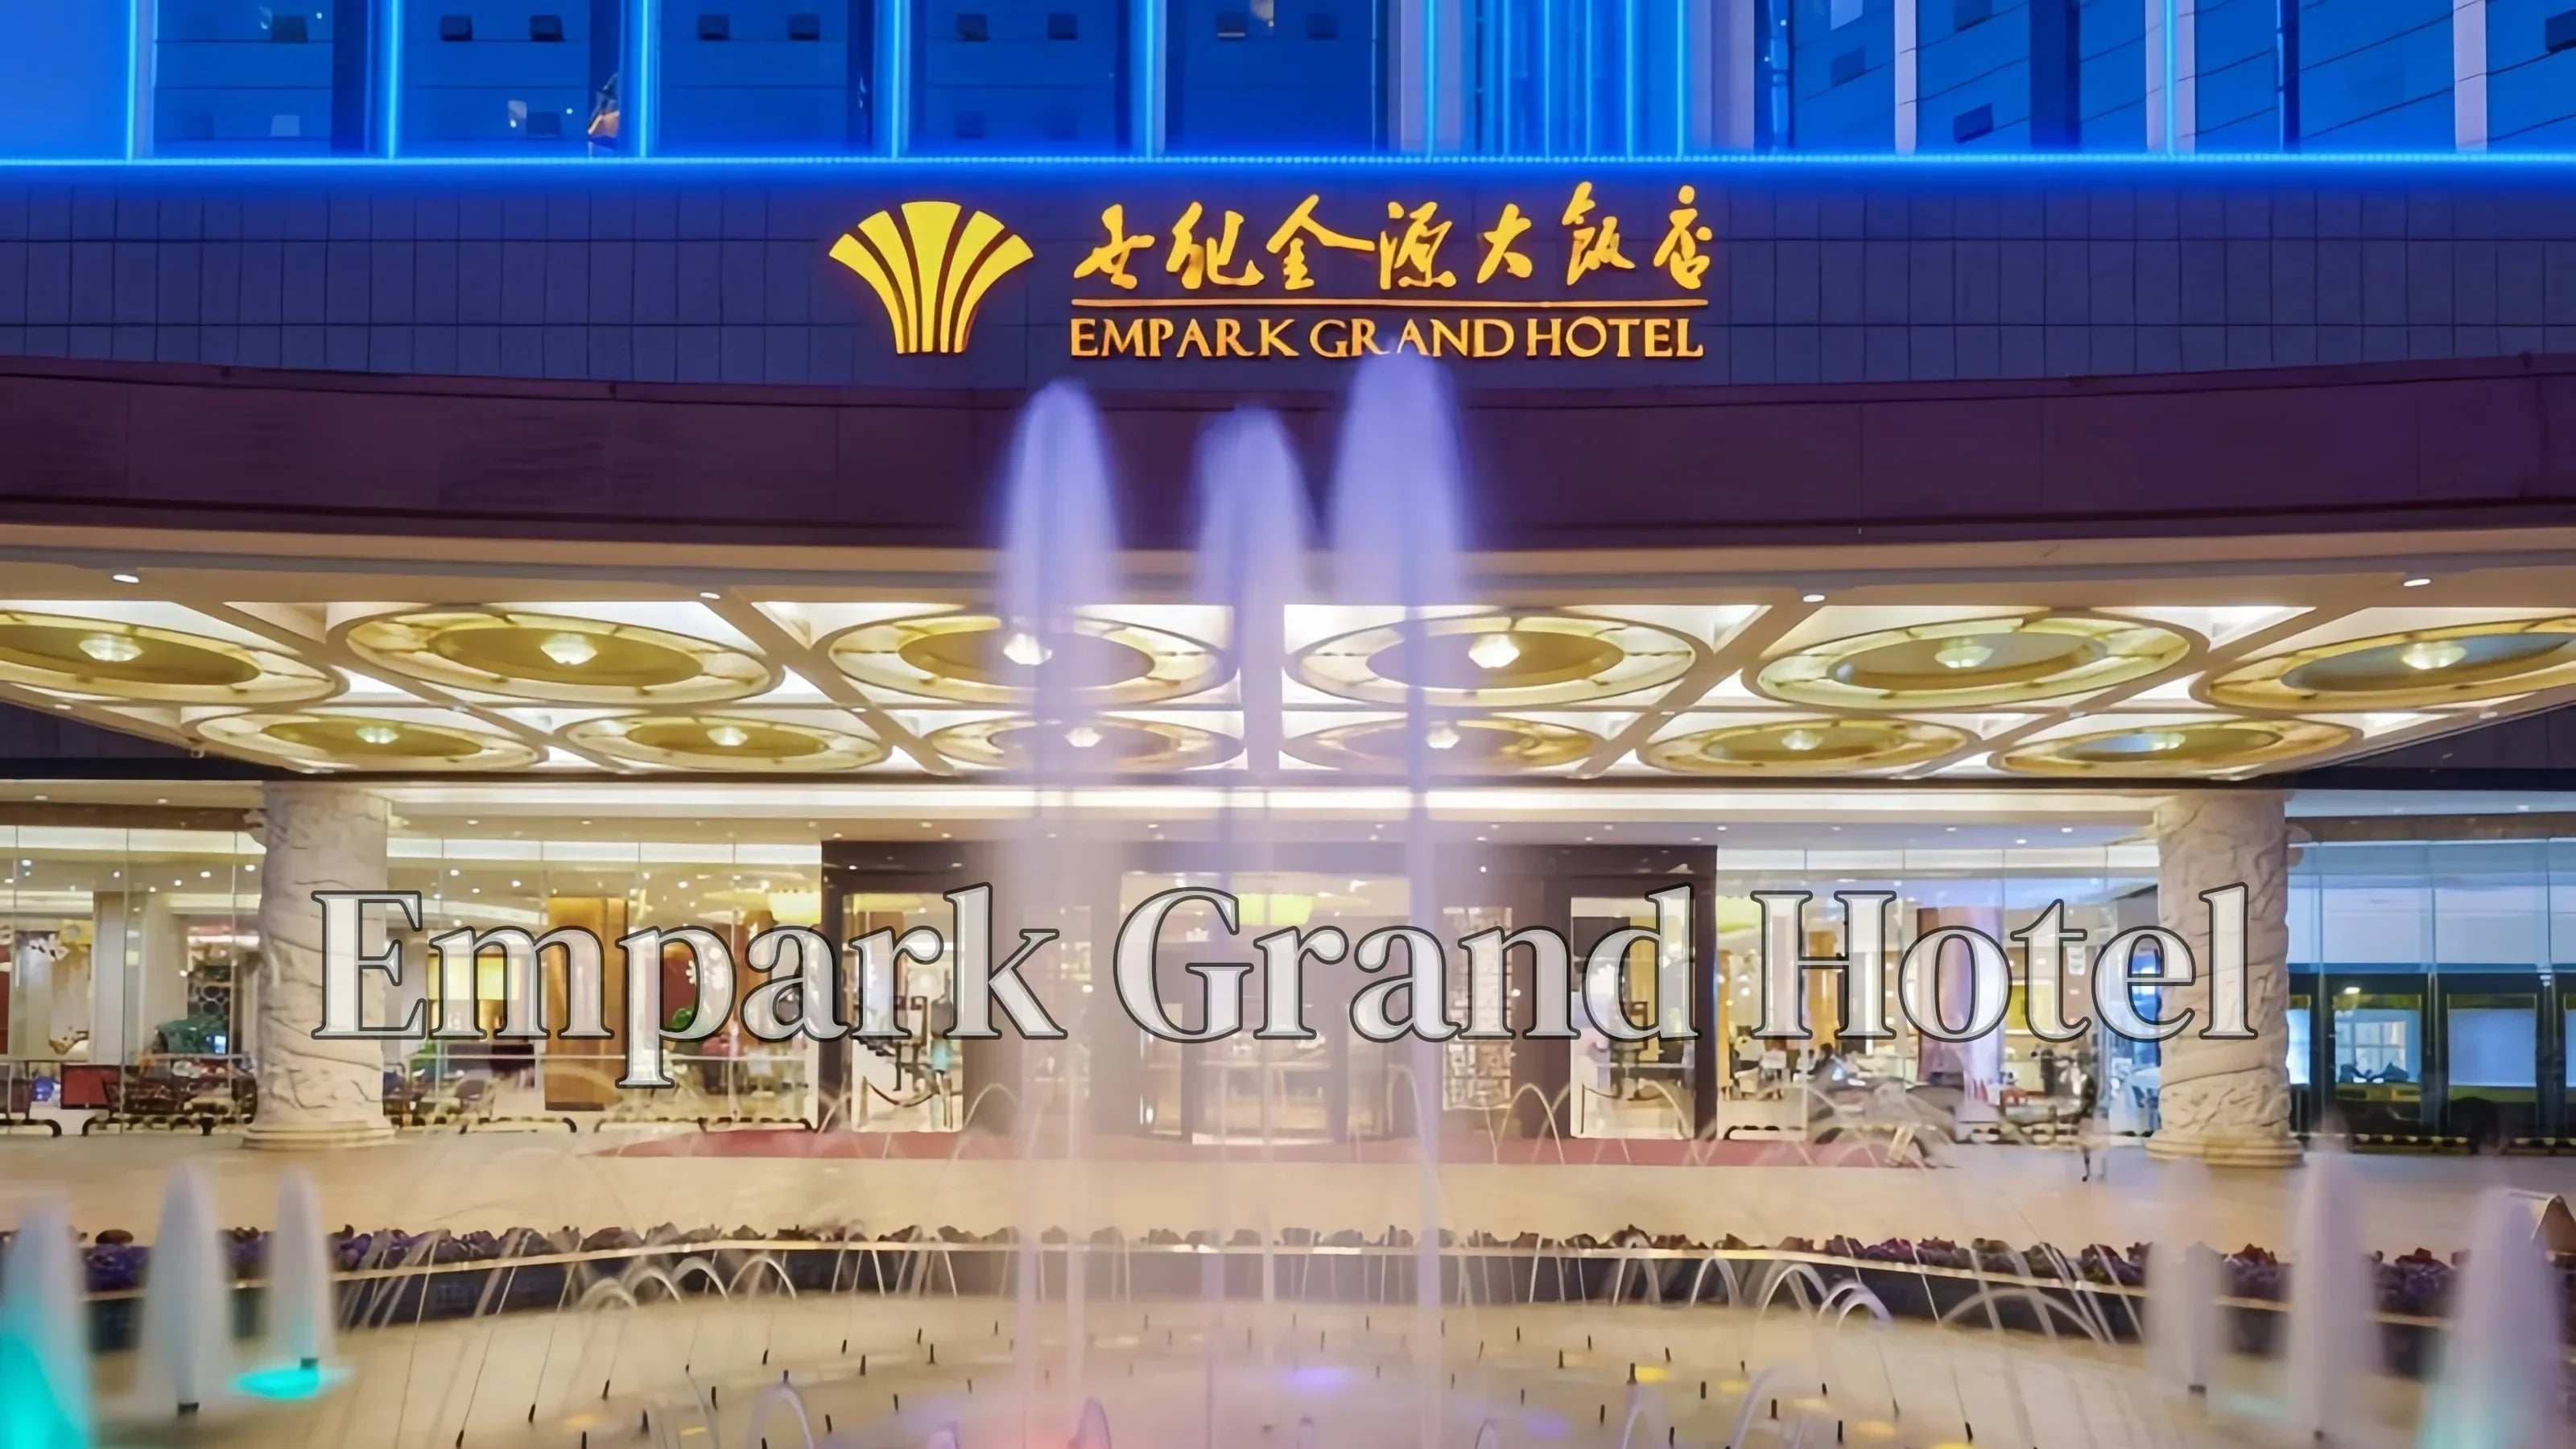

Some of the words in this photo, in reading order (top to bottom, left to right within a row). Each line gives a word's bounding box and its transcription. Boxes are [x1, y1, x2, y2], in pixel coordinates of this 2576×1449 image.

[1071, 318, 1300, 358] EMPARK
[1309, 318, 1515, 358] GRAND
[1526, 315, 1704, 357] HOTEL
